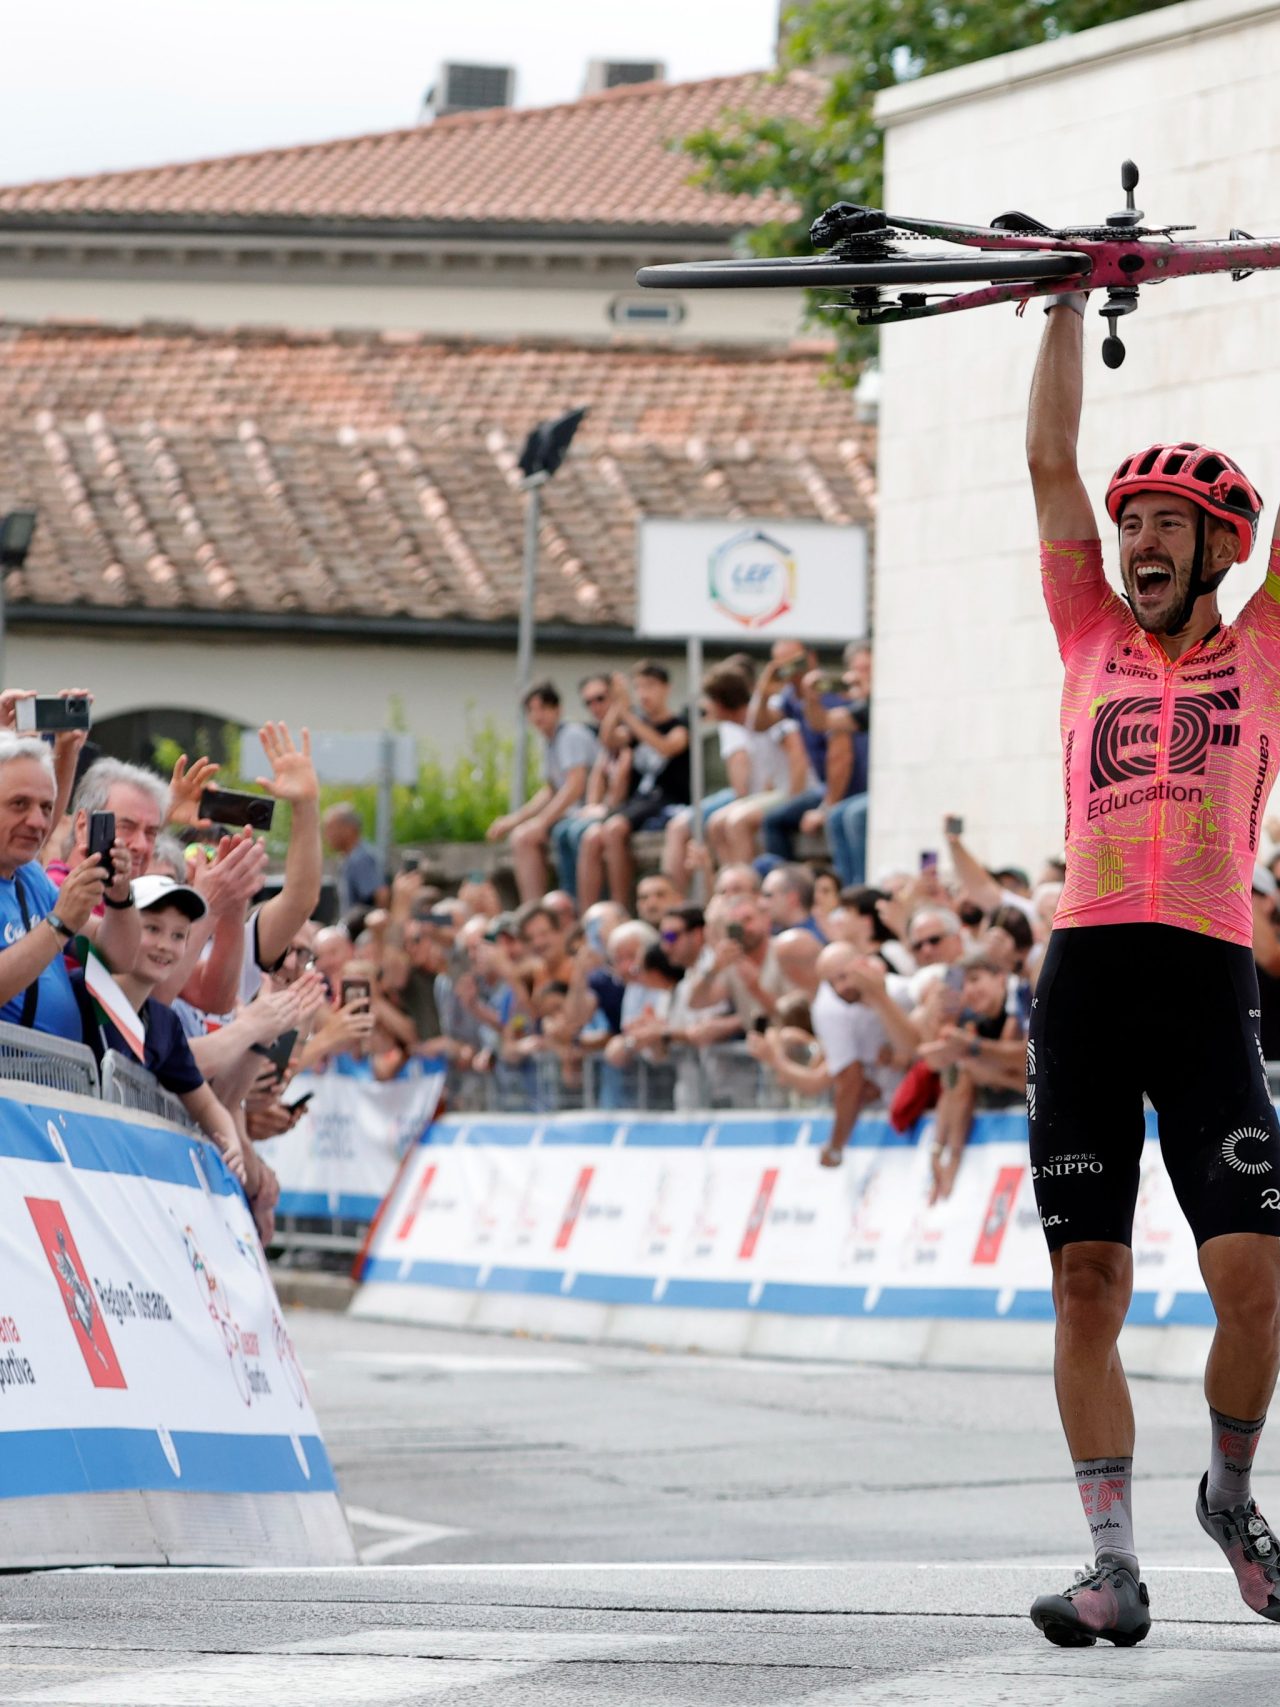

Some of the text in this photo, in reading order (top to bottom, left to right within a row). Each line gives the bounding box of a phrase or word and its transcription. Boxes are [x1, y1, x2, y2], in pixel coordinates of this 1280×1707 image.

[1181, 641, 1237, 667] easypost
[1118, 667, 1158, 680] NIPPO
[1181, 666, 1236, 682] wahoo
[1087, 781, 1202, 821] Education
[1249, 734, 1269, 852] cannondale
[1042, 1161, 1103, 1178] NIPPO
